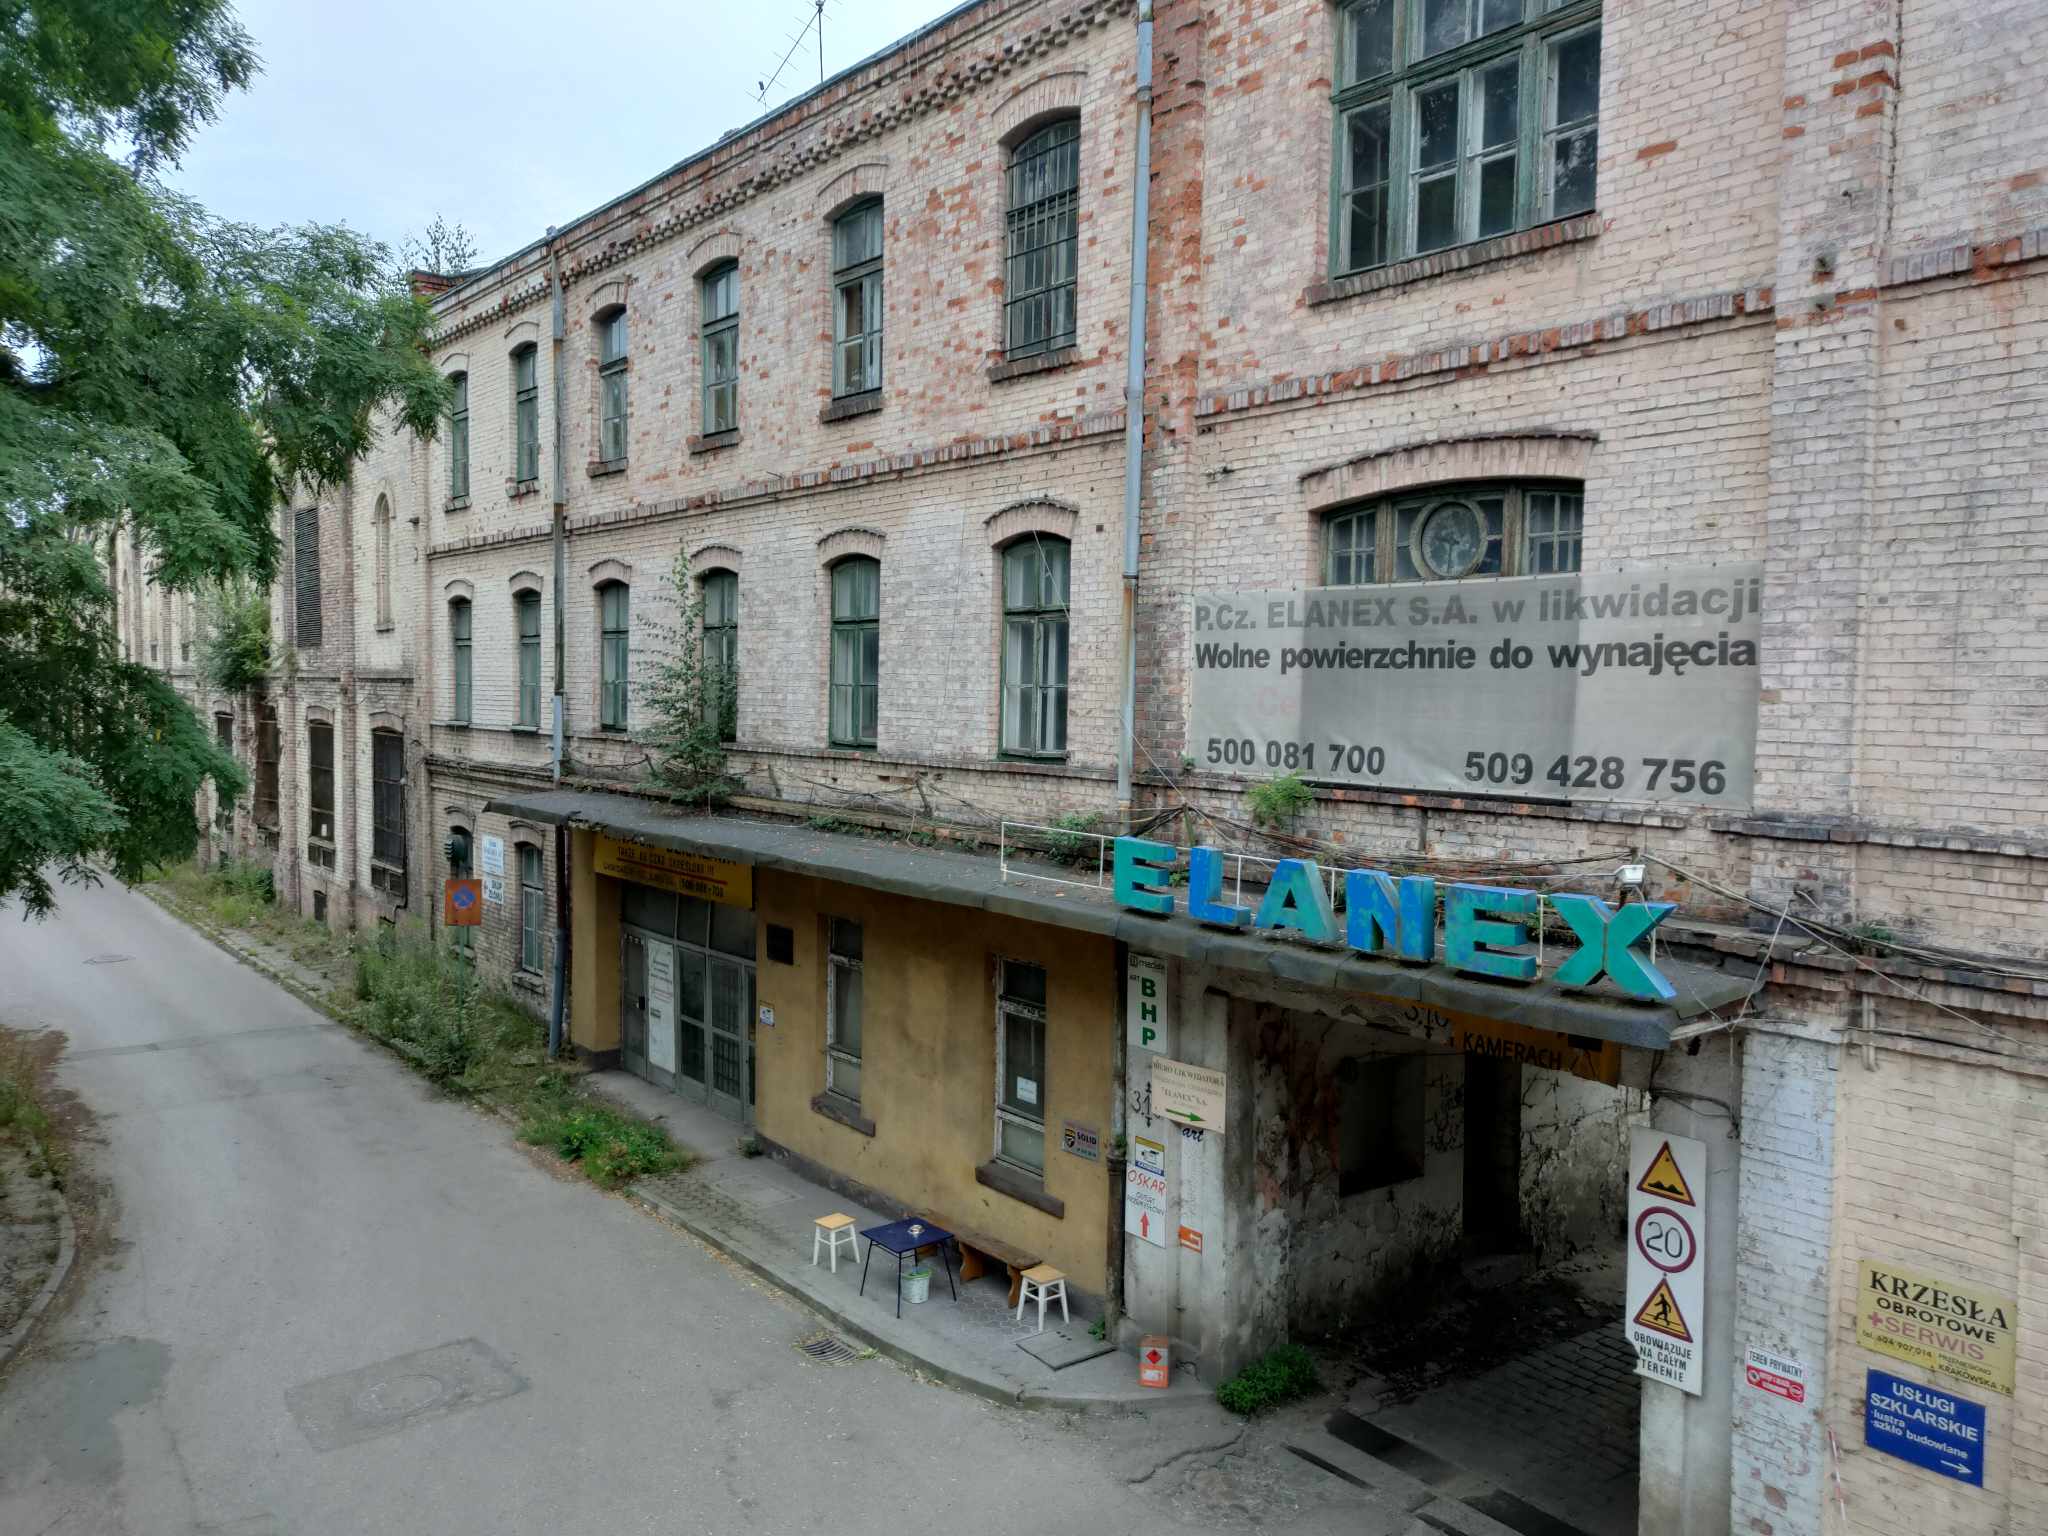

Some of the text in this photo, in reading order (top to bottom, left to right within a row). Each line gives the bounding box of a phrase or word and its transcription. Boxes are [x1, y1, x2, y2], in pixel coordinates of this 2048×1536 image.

[1195, 578, 1760, 631] P.Cz. ELANEX S.A. w likwidacji
[1195, 631, 1757, 677] Wolne powierzchnie do wynajęcia
[1206, 737, 1385, 775] 500 081 700
[1464, 751, 1727, 795] 509 428 756
[1112, 835, 1679, 999] ELANEX
[1141, 976, 1157, 1046] BHP
[1463, 1031, 1562, 1071] KAMERACH
[1128, 1169, 1166, 1196] OSKAR
[1645, 1220, 1684, 1259] 20
[1869, 1269, 2009, 1330] KRZESŁA
[1876, 1297, 1996, 1344] OBROTOWE
[1633, 1330, 1693, 1360] OBOWIĄZUJE
[1639, 1346, 1687, 1370] NA CAŁYM
[1641, 1359, 1685, 1382] TERENIE
[1768, 1358, 1803, 1378] PRYWATNY
[1938, 1364, 1997, 1390] KRAKOWSKA
[1870, 1392, 1979, 1442] SZKLARSKIE
[1892, 1382, 1955, 1415] USŁUGI
[1906, 1429, 1969, 1459] budowlane
